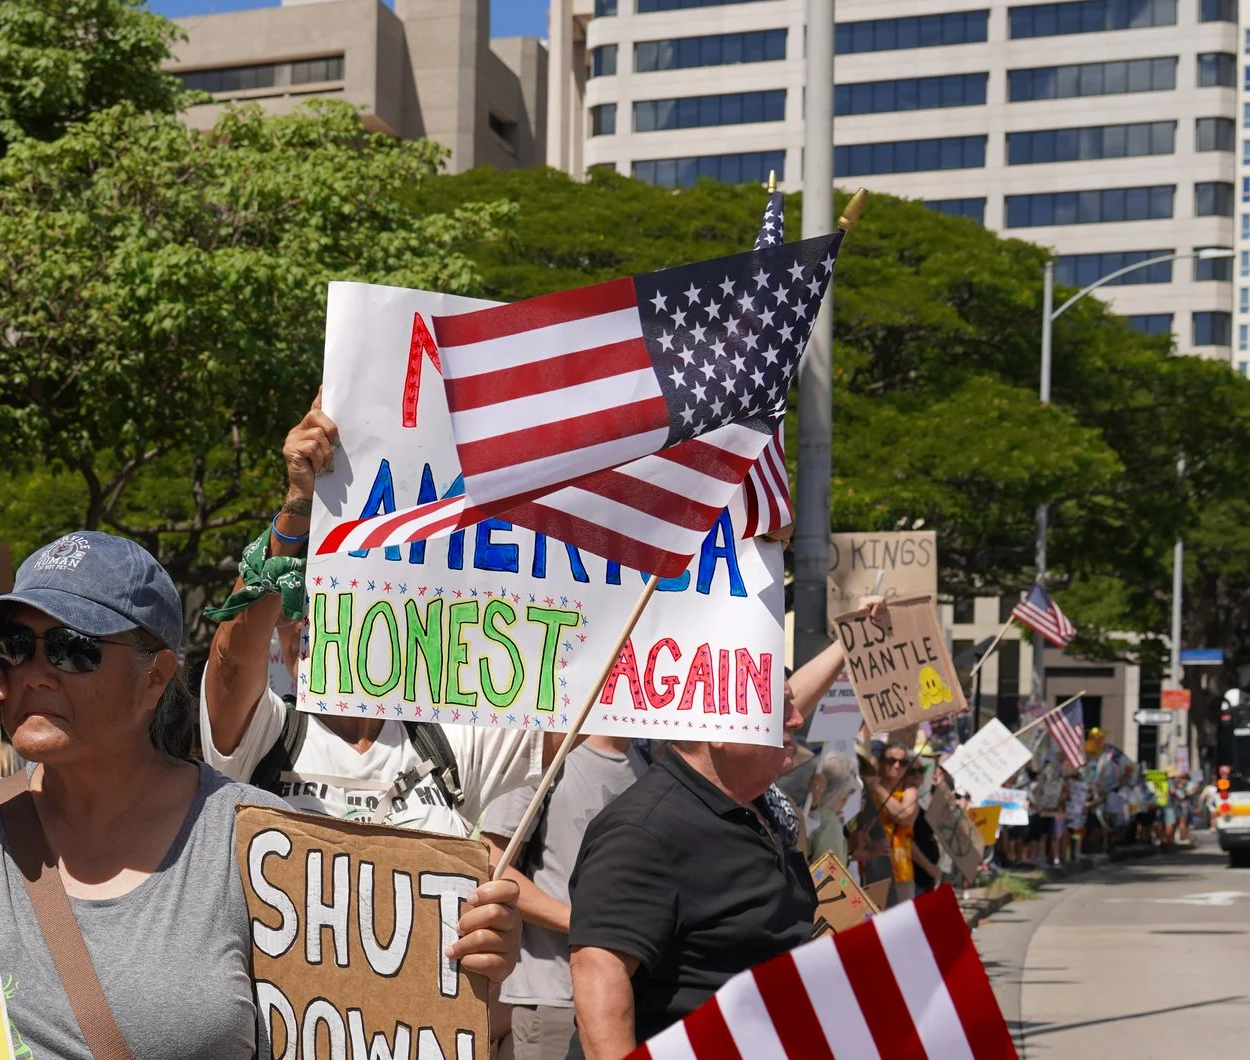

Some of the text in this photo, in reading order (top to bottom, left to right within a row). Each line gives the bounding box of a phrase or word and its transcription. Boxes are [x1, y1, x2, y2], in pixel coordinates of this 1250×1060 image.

[34, 556, 81, 568] HUMAN
[851, 538, 934, 571] KINGS
[309, 593, 580, 711] HONEST
[599, 636, 772, 715] AGAIN
[849, 636, 938, 684] MANTLE
[863, 682, 914, 724] THIS:
[247, 828, 479, 998] SHUT
